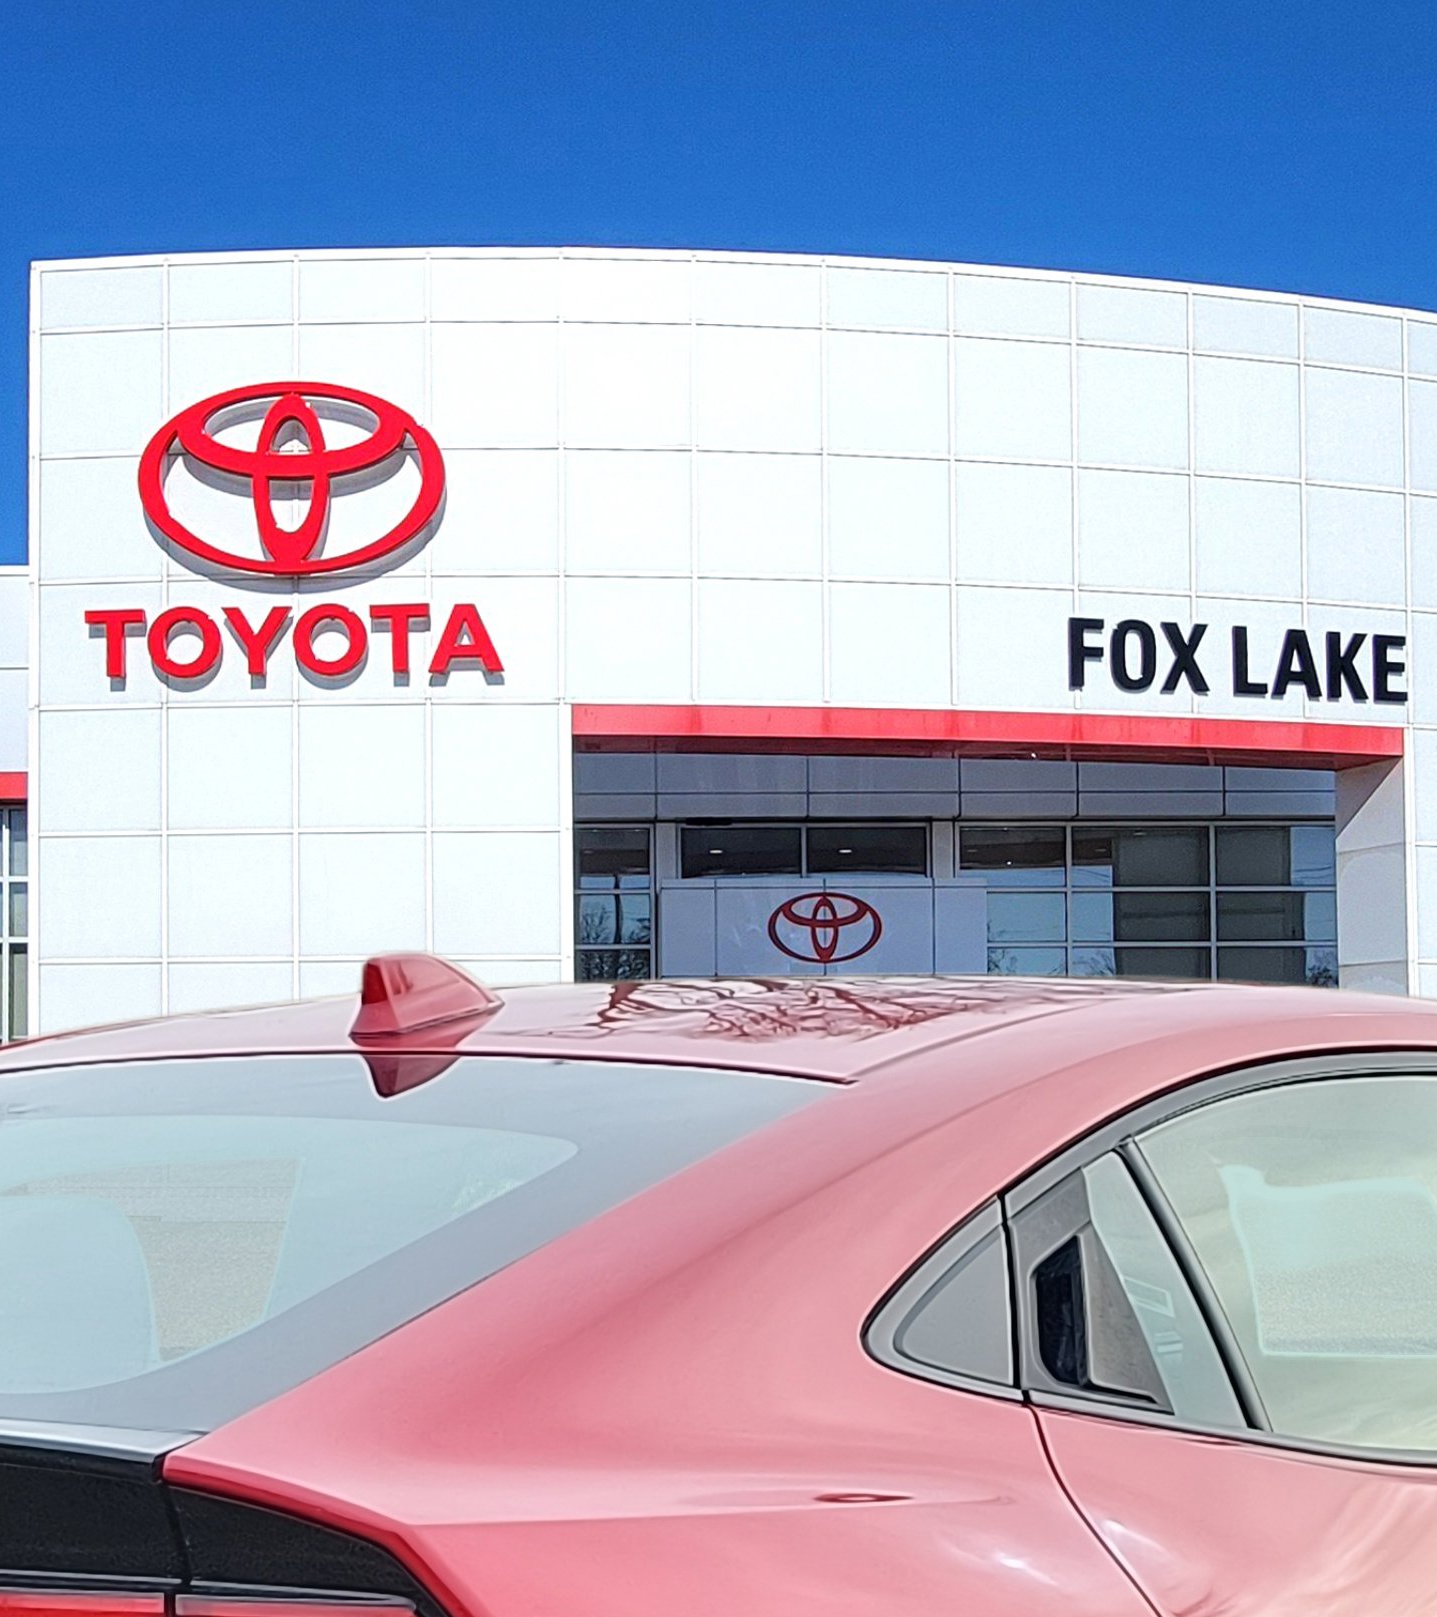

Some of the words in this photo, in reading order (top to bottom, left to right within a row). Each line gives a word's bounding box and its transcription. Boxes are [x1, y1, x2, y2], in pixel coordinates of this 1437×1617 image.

[85, 603, 504, 691] TOYOTA
[1068, 617, 1209, 694] FOX
[1231, 625, 1409, 702] LAKE
